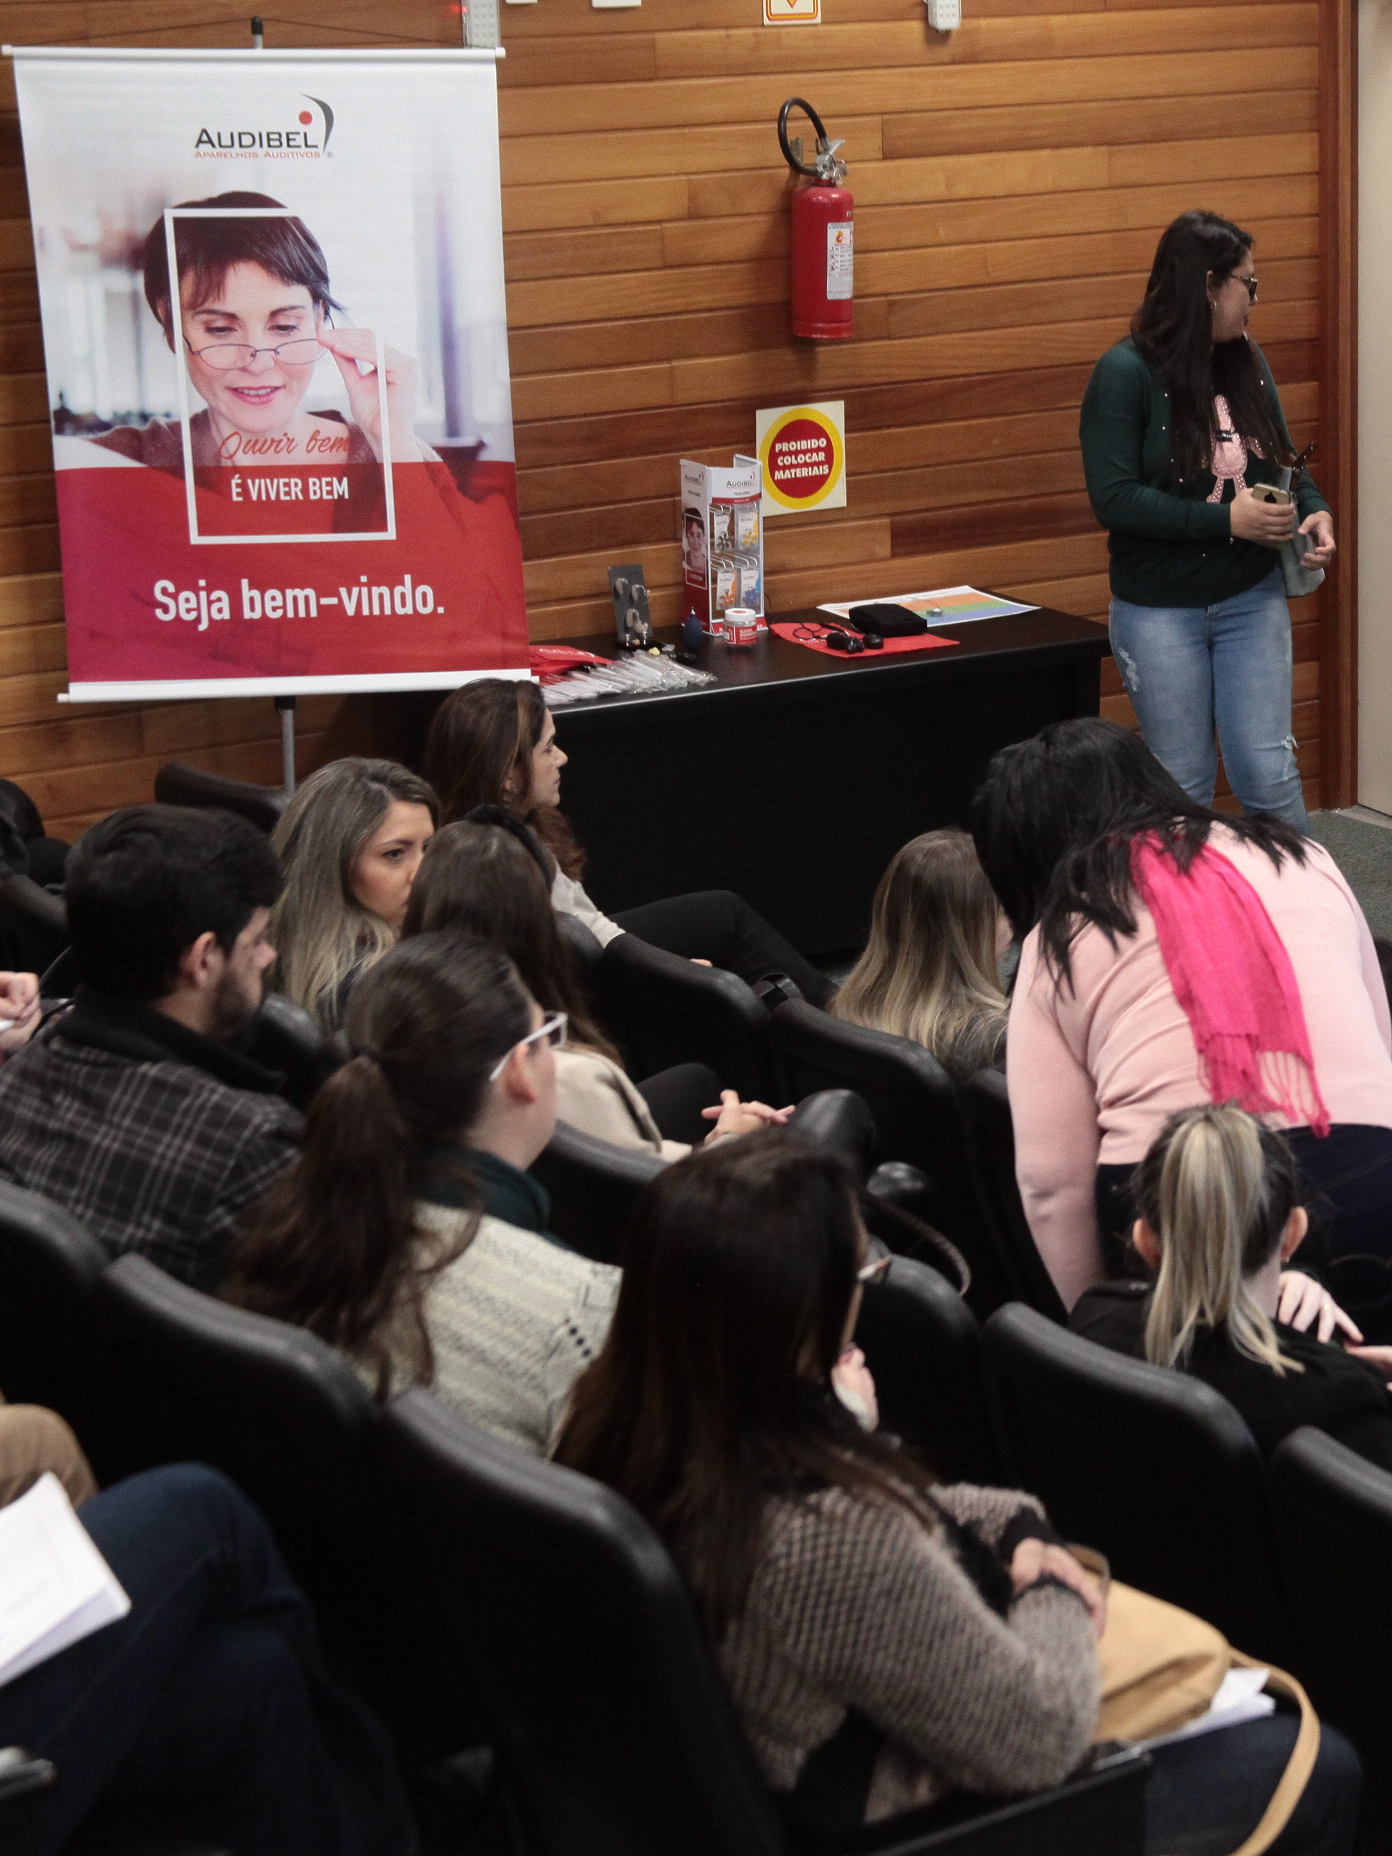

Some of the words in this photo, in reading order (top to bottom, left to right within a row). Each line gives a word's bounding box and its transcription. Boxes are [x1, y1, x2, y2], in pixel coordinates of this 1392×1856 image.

[194, 127, 319, 149] AUDIBEL
[194, 150, 259, 159] APARELHOS
[263, 150, 321, 159] AUDITIVOS
[218, 430, 299, 460] Ouvir
[305, 429, 352, 454] bem
[775, 437, 827, 453] PROIBIDO
[777, 451, 826, 467] COLOCAR
[774, 464, 829, 480] MATERIAIS
[230, 473, 244, 502] É
[246, 477, 304, 502] VIVER
[308, 476, 350, 500] BEM
[153, 579, 231, 631] Seja
[241, 574, 445, 619] bem-vindo.
